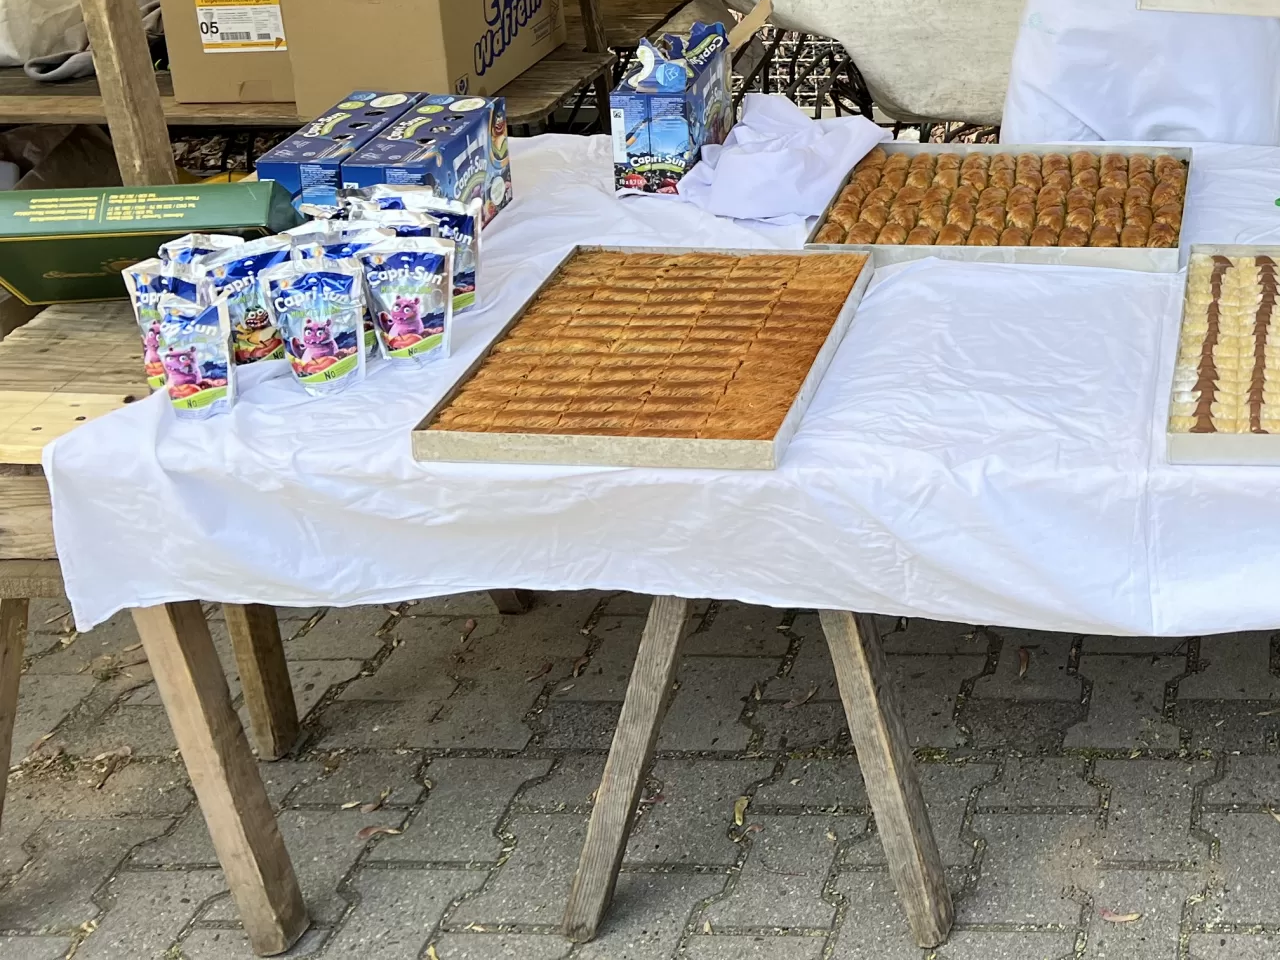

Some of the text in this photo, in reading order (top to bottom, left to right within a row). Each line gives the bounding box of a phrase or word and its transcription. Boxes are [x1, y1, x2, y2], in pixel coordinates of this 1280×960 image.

[200, 21, 219, 34] 05
[630, 153, 686, 168] Capri-Sun
[366, 264, 444, 286] Capri-Sun
[324, 371, 336, 381] No
[187, 398, 198, 409] No
